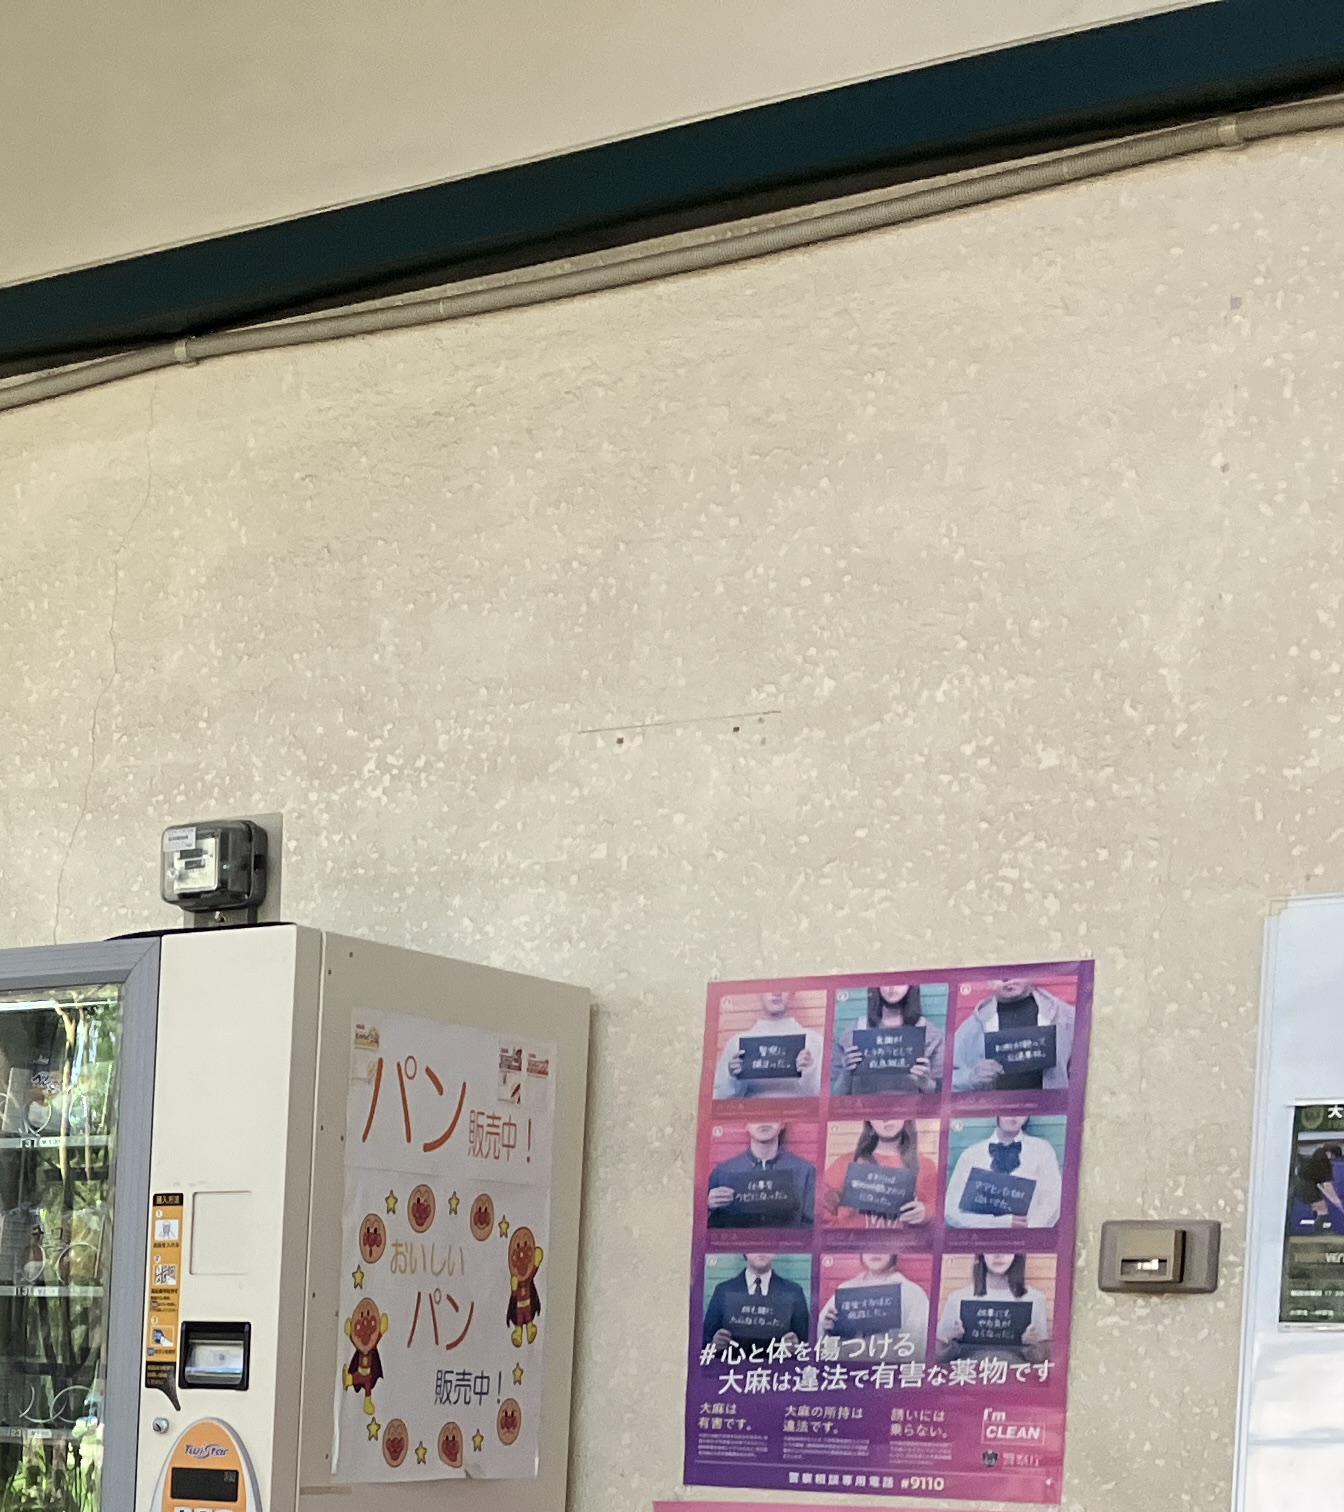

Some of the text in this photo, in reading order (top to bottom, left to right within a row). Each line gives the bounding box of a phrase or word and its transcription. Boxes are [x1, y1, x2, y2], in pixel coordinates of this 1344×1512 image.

[362, 1055, 467, 1152] パン
[390, 1239, 465, 1278] おいしい
[407, 1288, 475, 1351] パン
[699, 1332, 916, 1366] #心と体を傷つける
[717, 1359, 1055, 1395] 大麻は違法で有害な薬物です
[986, 1425, 1041, 1441] CLEAN
